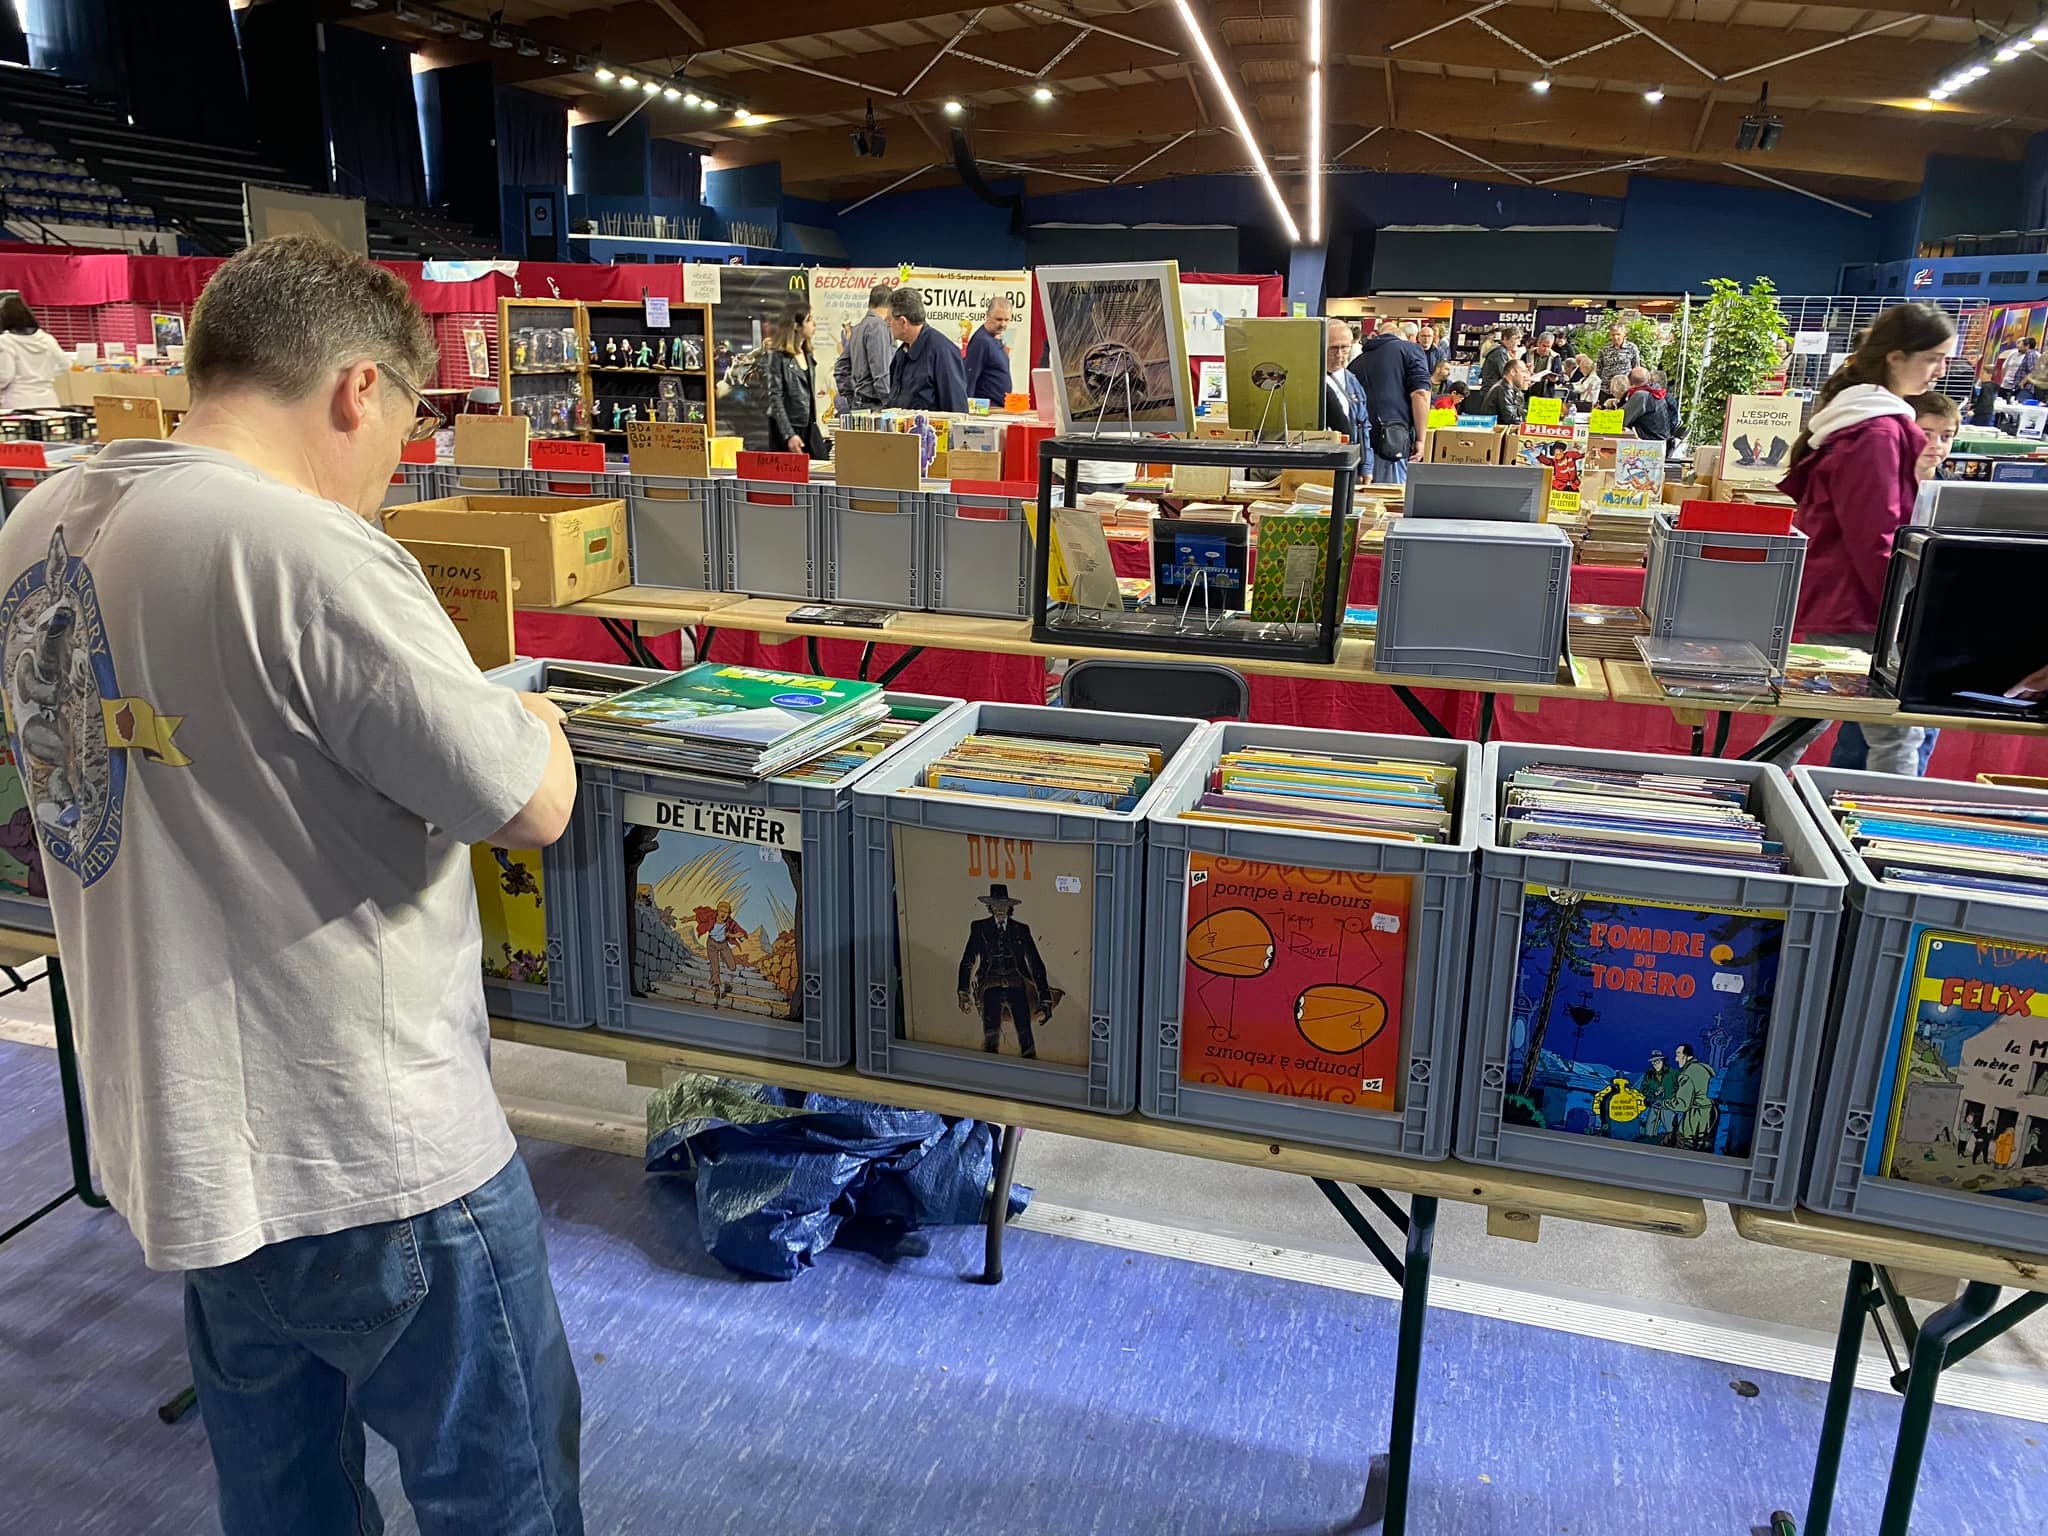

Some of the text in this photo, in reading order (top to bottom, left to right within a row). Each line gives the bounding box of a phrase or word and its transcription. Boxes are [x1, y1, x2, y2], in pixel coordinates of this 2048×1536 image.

[815, 272, 877, 289] BÉDÉCINÉ
[936, 272, 996, 282] 14-15 Septembre
[1070, 284, 1139, 295] GIL JOURDAN
[918, 288, 976, 308] STIVAL
[1005, 291, 1026, 309] BD
[1499, 312, 1533, 322] ESPAC
[1736, 417, 1769, 426] MALGRÉ
[1741, 410, 1789, 420] L'ESPOIR
[1524, 423, 1586, 438] Pilote 18
[1450, 455, 1463, 464] Top
[1602, 491, 1644, 506] Marvel
[423, 564, 482, 582] TIONS
[77, 565, 107, 657] WORRY
[656, 801, 785, 845] DE L'ENFER
[966, 834, 1033, 881] DUST
[1193, 872, 1207, 882] GA
[1213, 881, 1372, 910] pompe à rebours
[1588, 922, 1706, 958] L'OMBRE
[1633, 953, 1656, 969] DU
[1590, 964, 1696, 999] TORERO
[2004, 1039, 2022, 1054] la
[1204, 1045, 1362, 1078] pompe à rebours
[1973, 1057, 2020, 1073] mène
[1997, 1073, 2014, 1088] la
